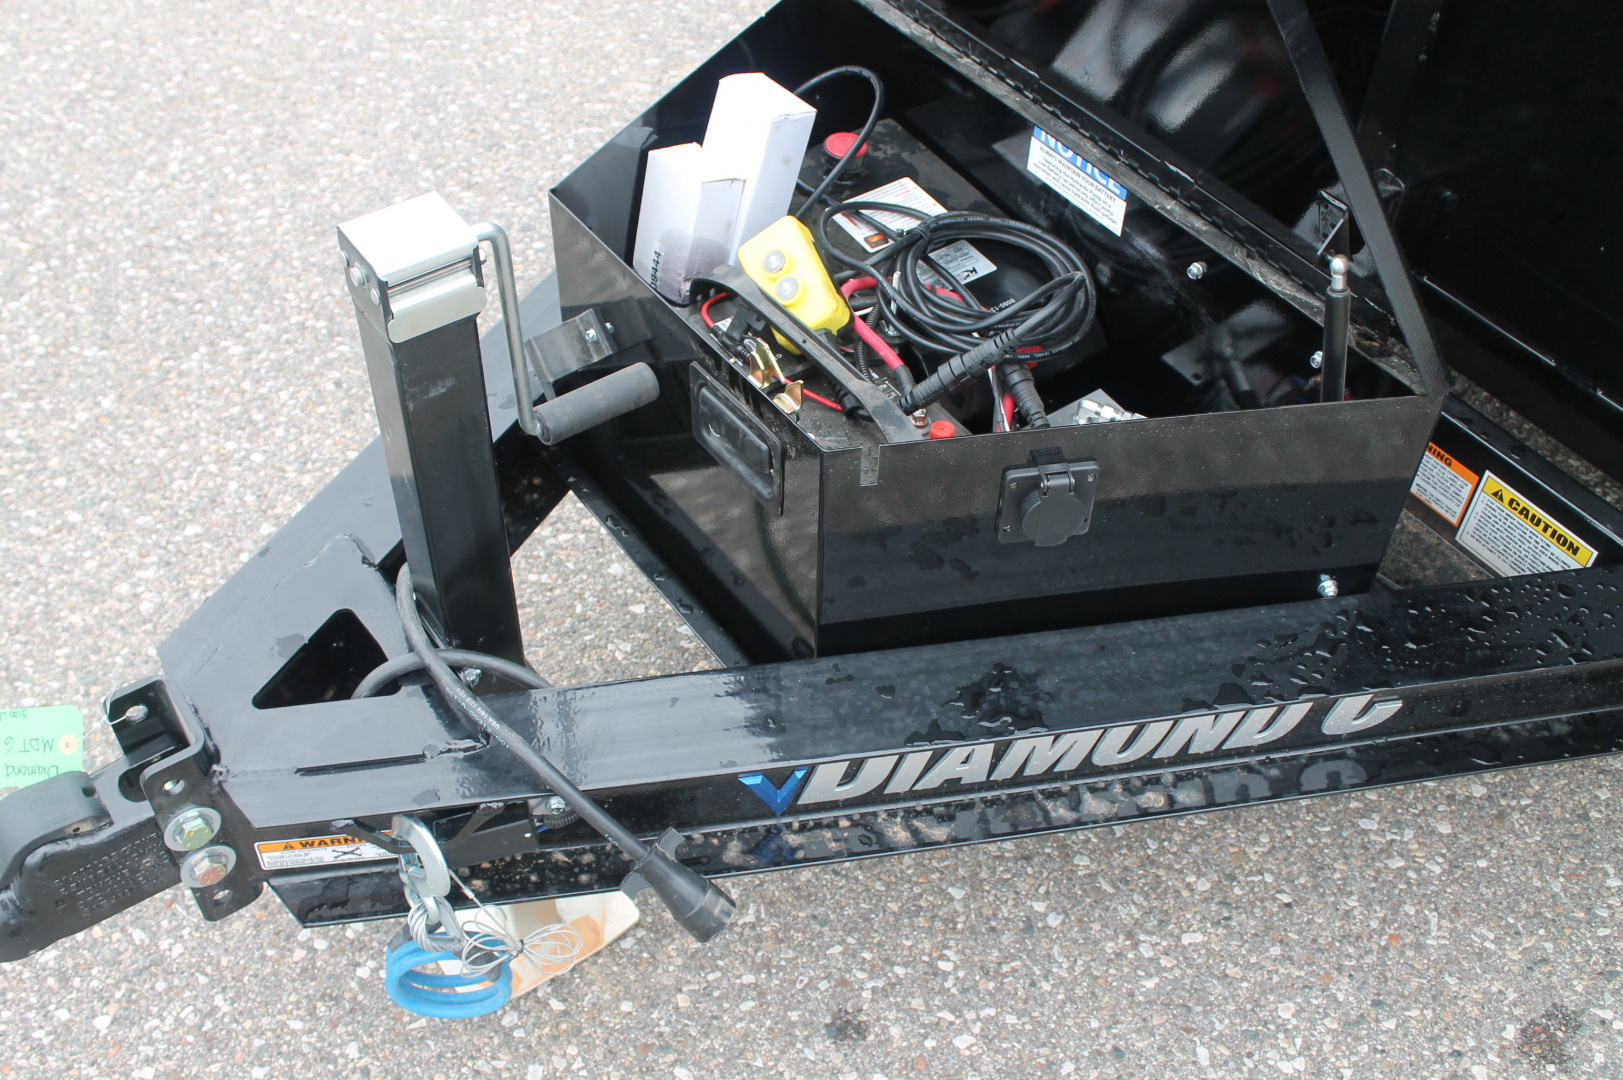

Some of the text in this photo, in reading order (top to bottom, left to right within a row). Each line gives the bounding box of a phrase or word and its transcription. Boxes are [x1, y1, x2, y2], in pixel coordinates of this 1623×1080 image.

[1057, 158, 1080, 178] MAINTAIN
[1081, 175, 1094, 188] YOUR
[1508, 498, 1580, 556] CAUTION
[488, 717, 500, 730] USA
[18, 736, 54, 754] MDT
[4, 762, 59, 778] Diamond
